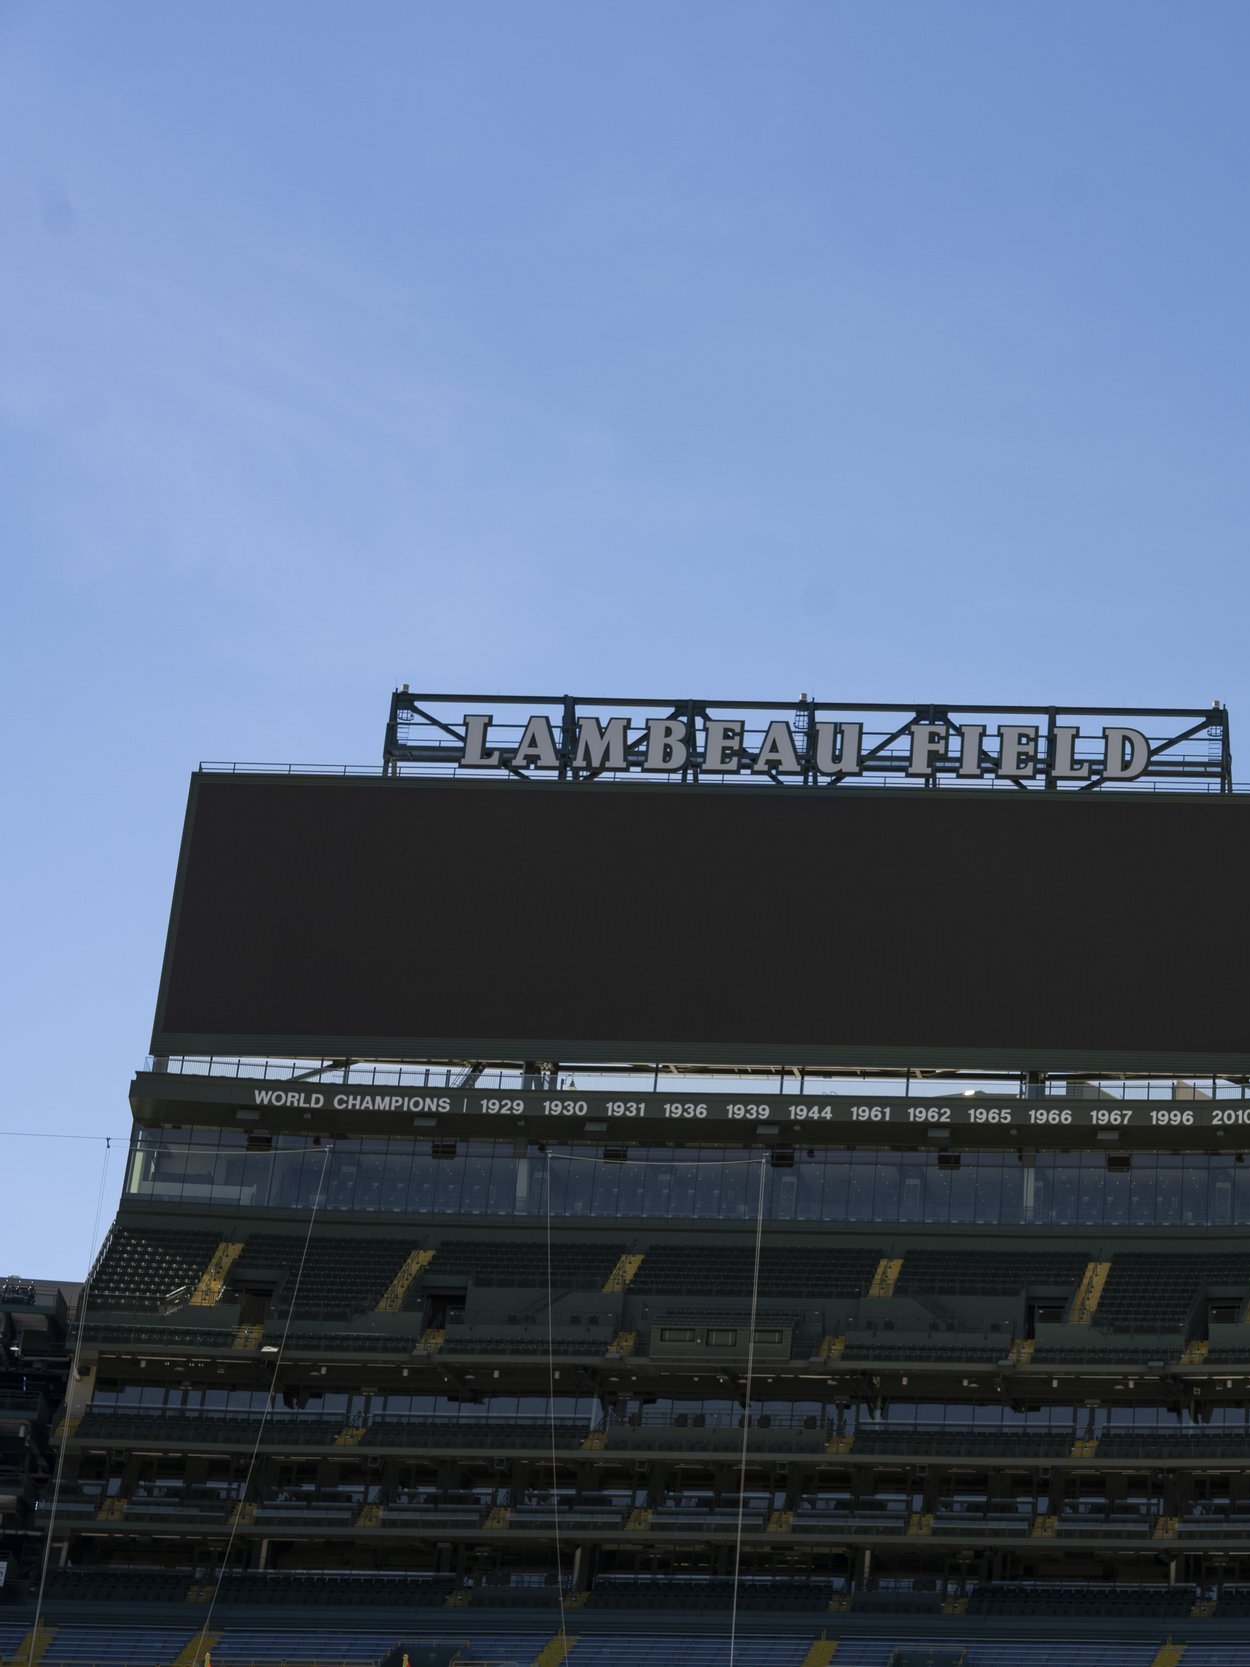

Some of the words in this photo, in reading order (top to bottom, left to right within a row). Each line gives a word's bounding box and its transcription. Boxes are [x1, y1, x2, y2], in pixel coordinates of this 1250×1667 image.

[459, 714, 863, 777] LAMBEAU
[906, 724, 1151, 781] FIELD
[254, 1089, 325, 1108] WORLD
[333, 1094, 451, 1113] CHAMPIONS
[480, 1099, 525, 1115] 1929
[543, 1100, 588, 1116] 1930
[605, 1101, 646, 1117] 1931
[663, 1103, 708, 1119] 1936
[726, 1104, 770, 1120] 1939
[788, 1105, 833, 1120] 1944
[850, 1106, 891, 1121] 1961
[907, 1107, 951, 1123] 1962
[967, 1108, 1012, 1124] 1965
[1028, 1109, 1073, 1125] 1966
[1089, 1109, 1133, 1125] 1967
[1149, 1110, 1194, 1126] 1996
